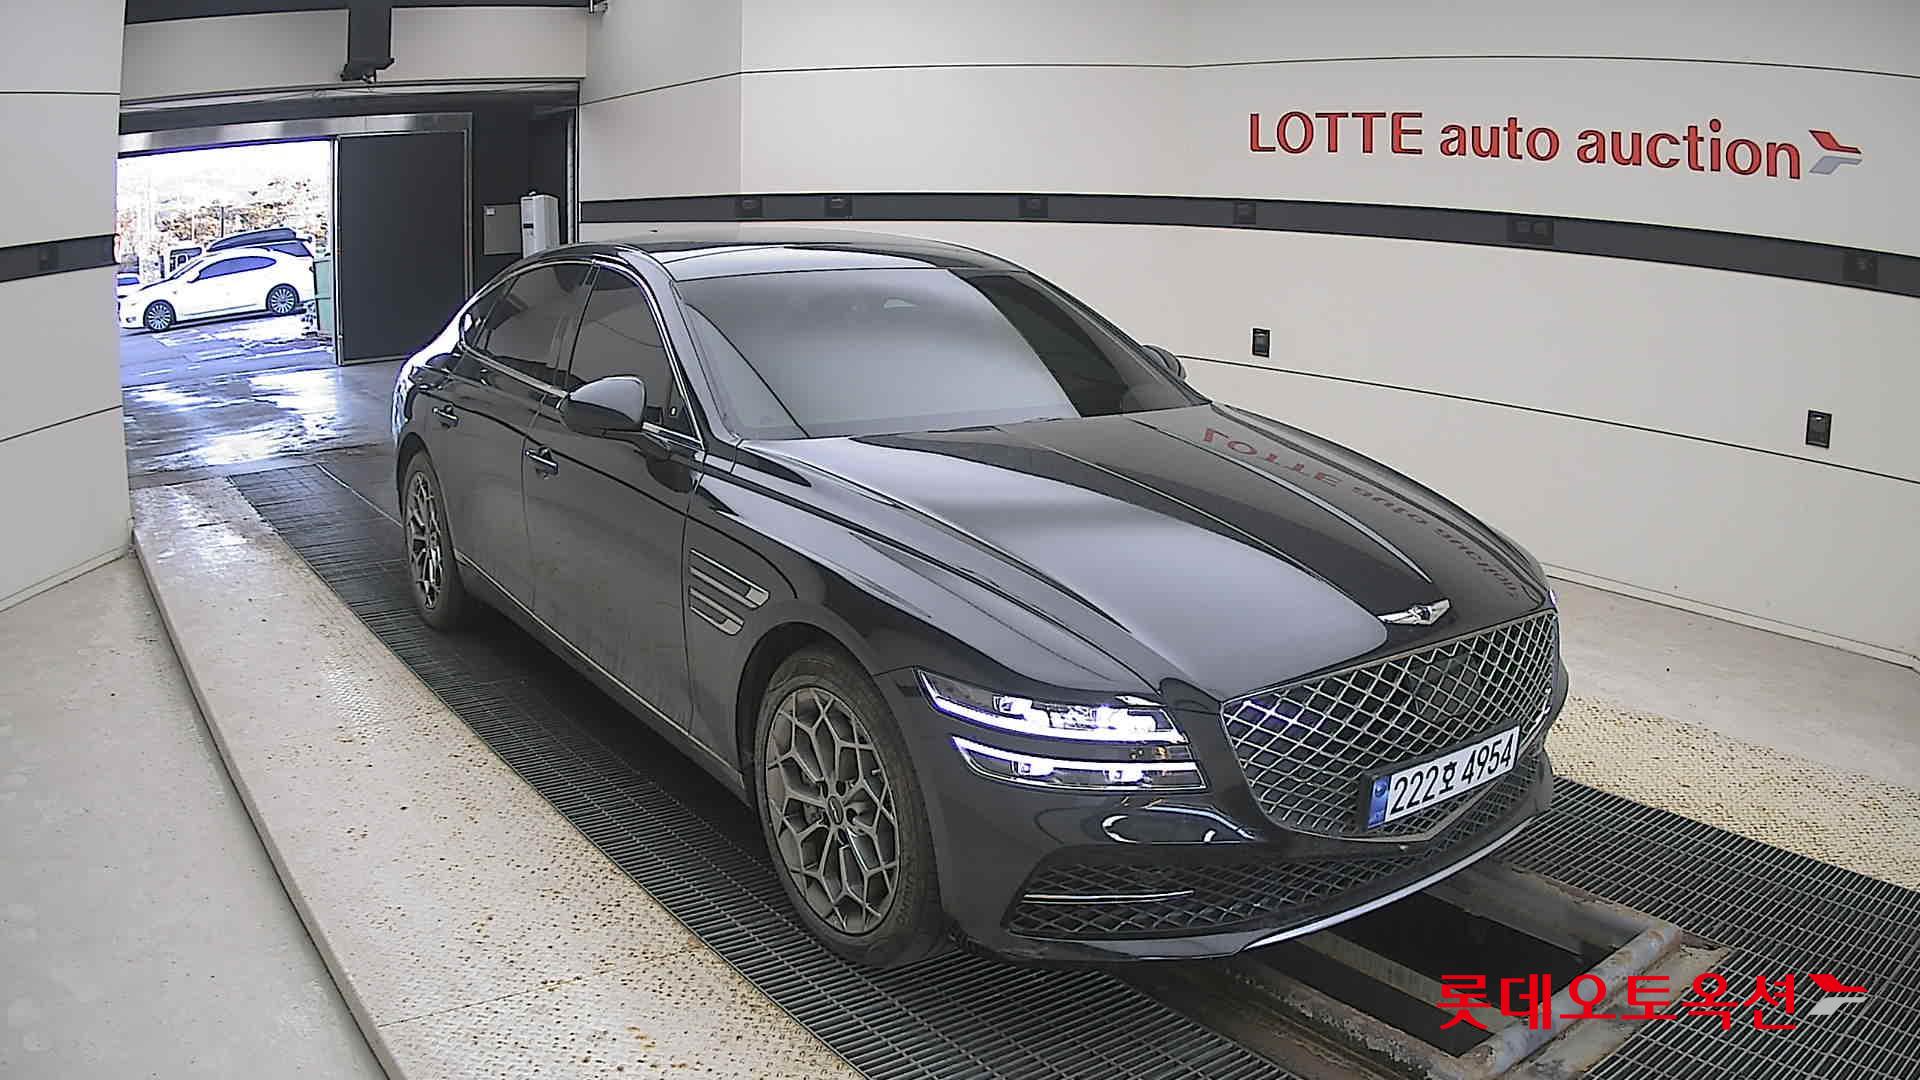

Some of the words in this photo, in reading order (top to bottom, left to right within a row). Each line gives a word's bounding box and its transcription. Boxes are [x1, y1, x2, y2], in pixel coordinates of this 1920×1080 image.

[1249, 111, 1423, 155] LOTTE
[1439, 117, 1560, 162] auto
[1575, 119, 1802, 180] auction
[1391, 761, 1458, 815] 222호
[1462, 733, 1513, 785] 4954
